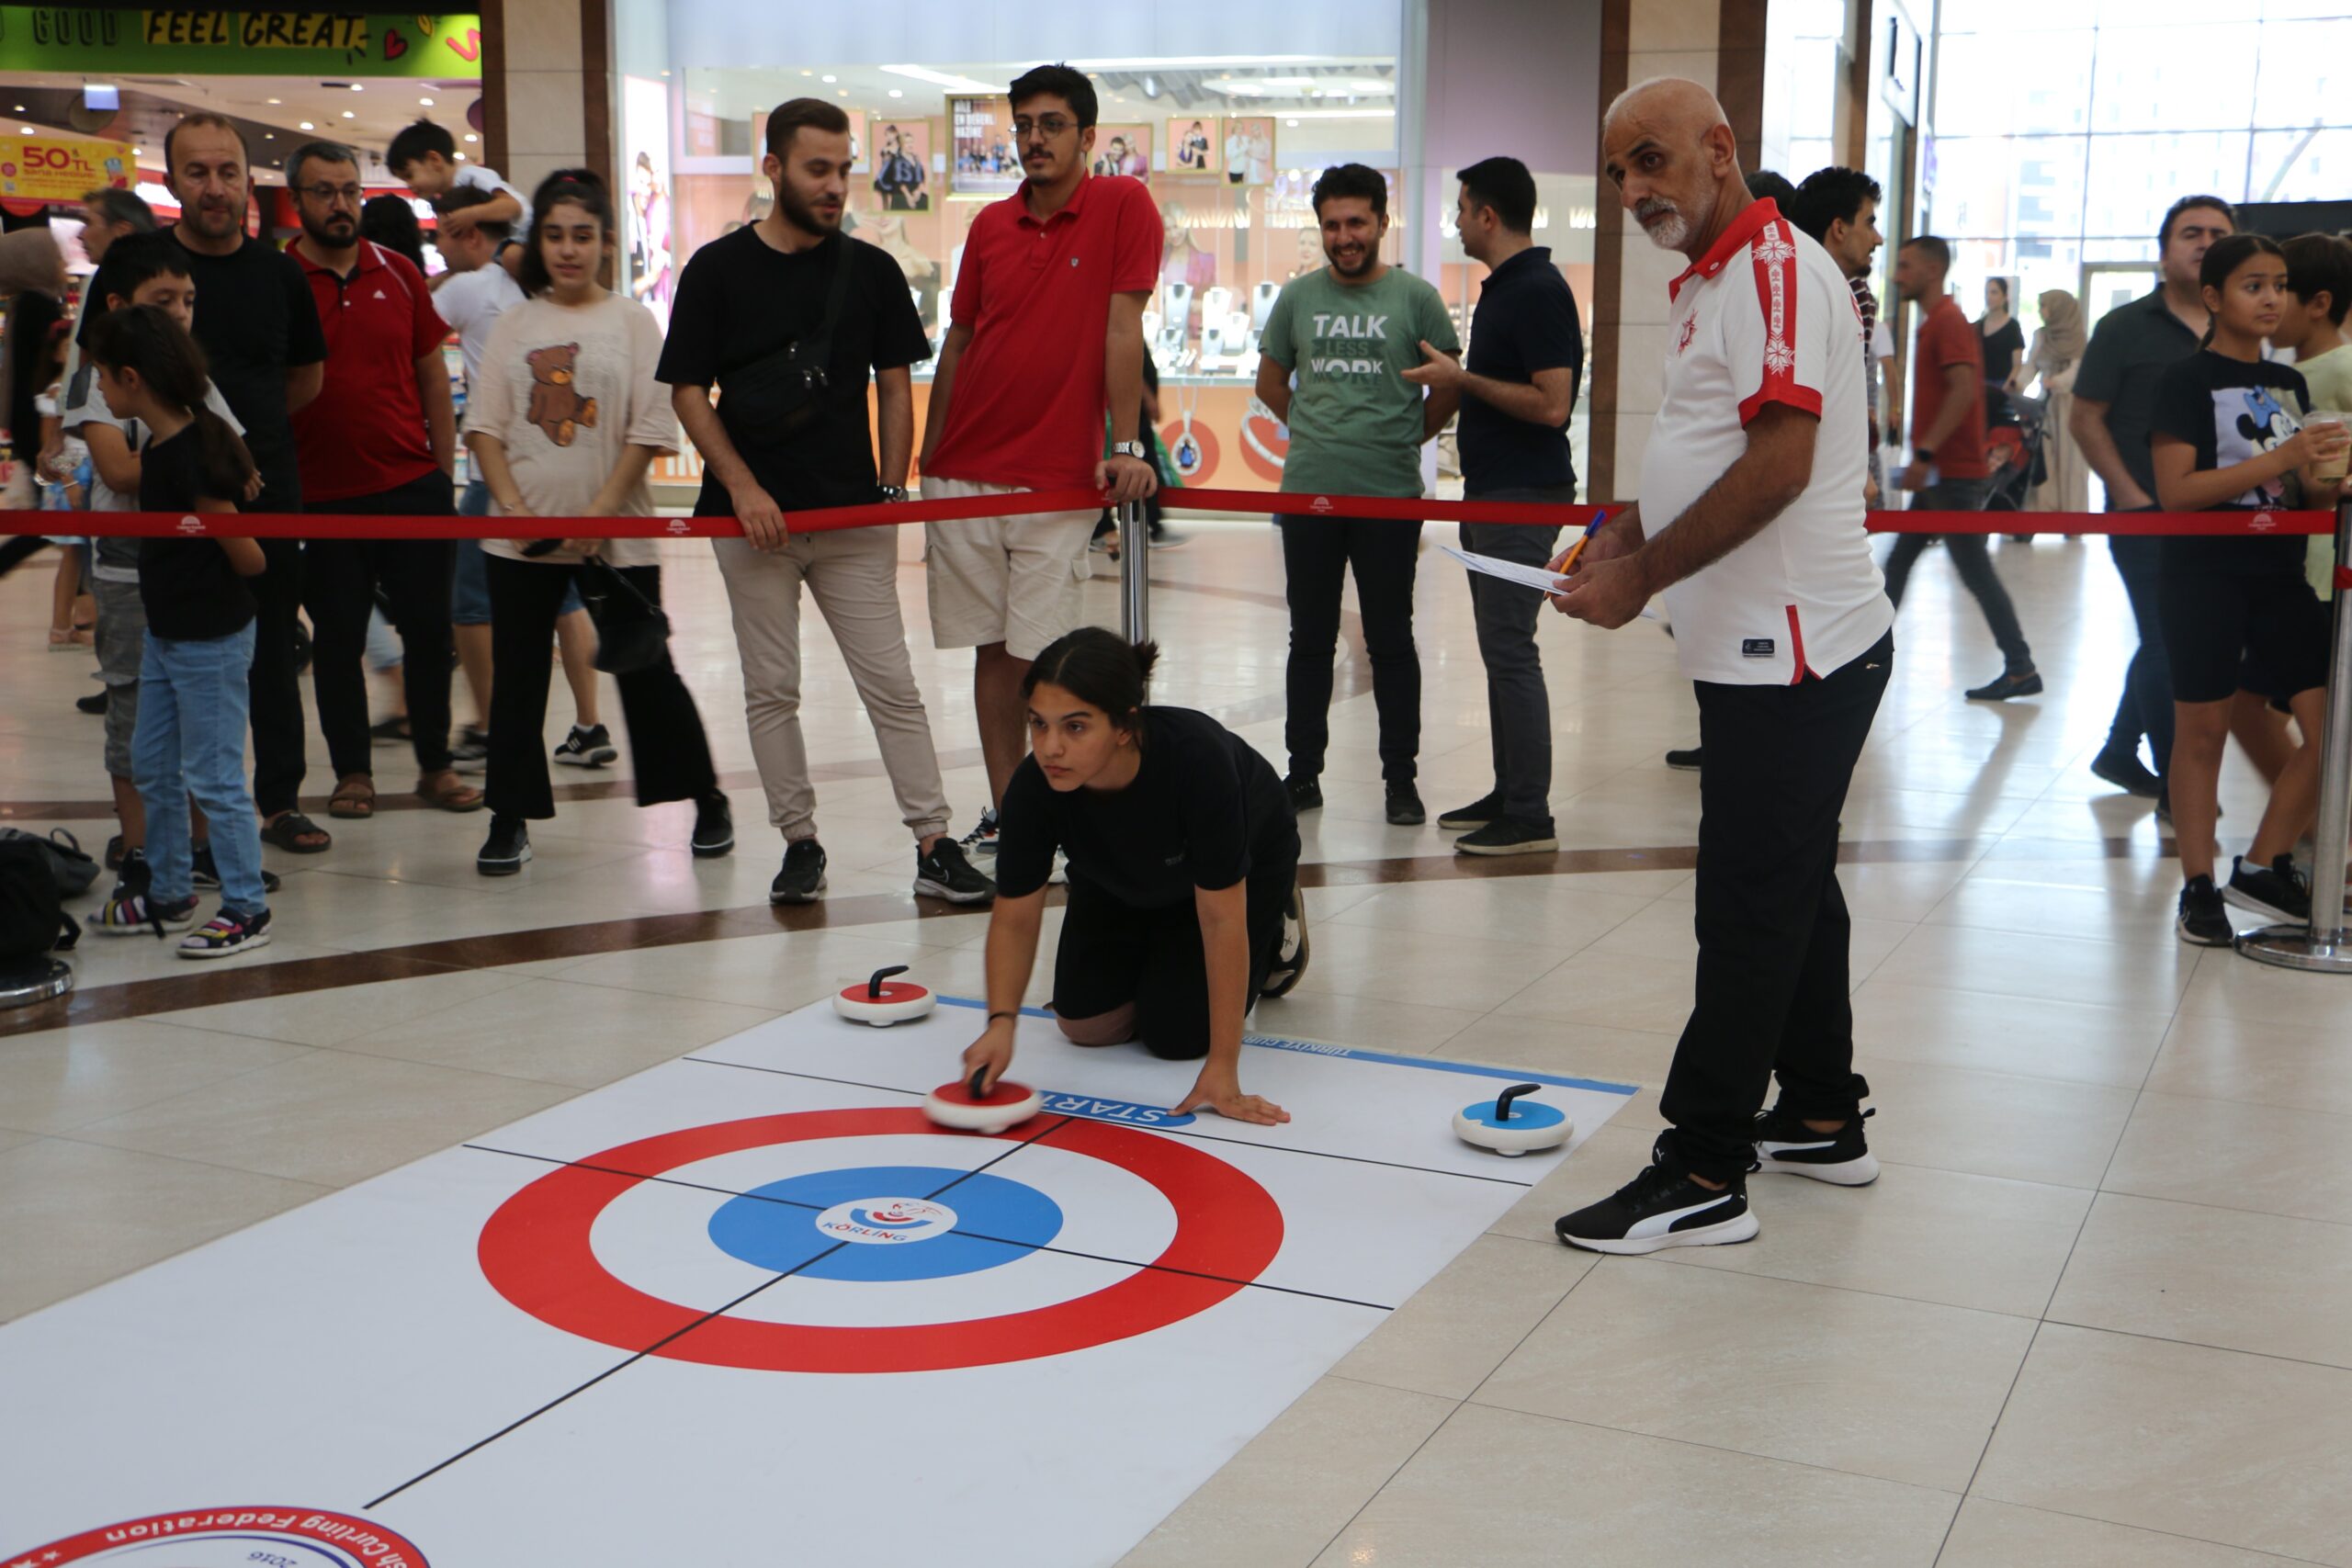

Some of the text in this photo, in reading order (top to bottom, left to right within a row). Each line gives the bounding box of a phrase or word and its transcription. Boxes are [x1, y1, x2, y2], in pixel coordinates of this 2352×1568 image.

[33, 7, 119, 45] GOOD
[147, 11, 228, 44] FEEL
[243, 12, 364, 47] GREAT
[23, 146, 70, 170] 50
[73, 158, 96, 174] TL
[1313, 315, 1388, 338] TALK
[1326, 341, 1368, 356] LESS
[1311, 358, 1384, 376] WORK
[105, 1512, 390, 1556] Curling Federation
